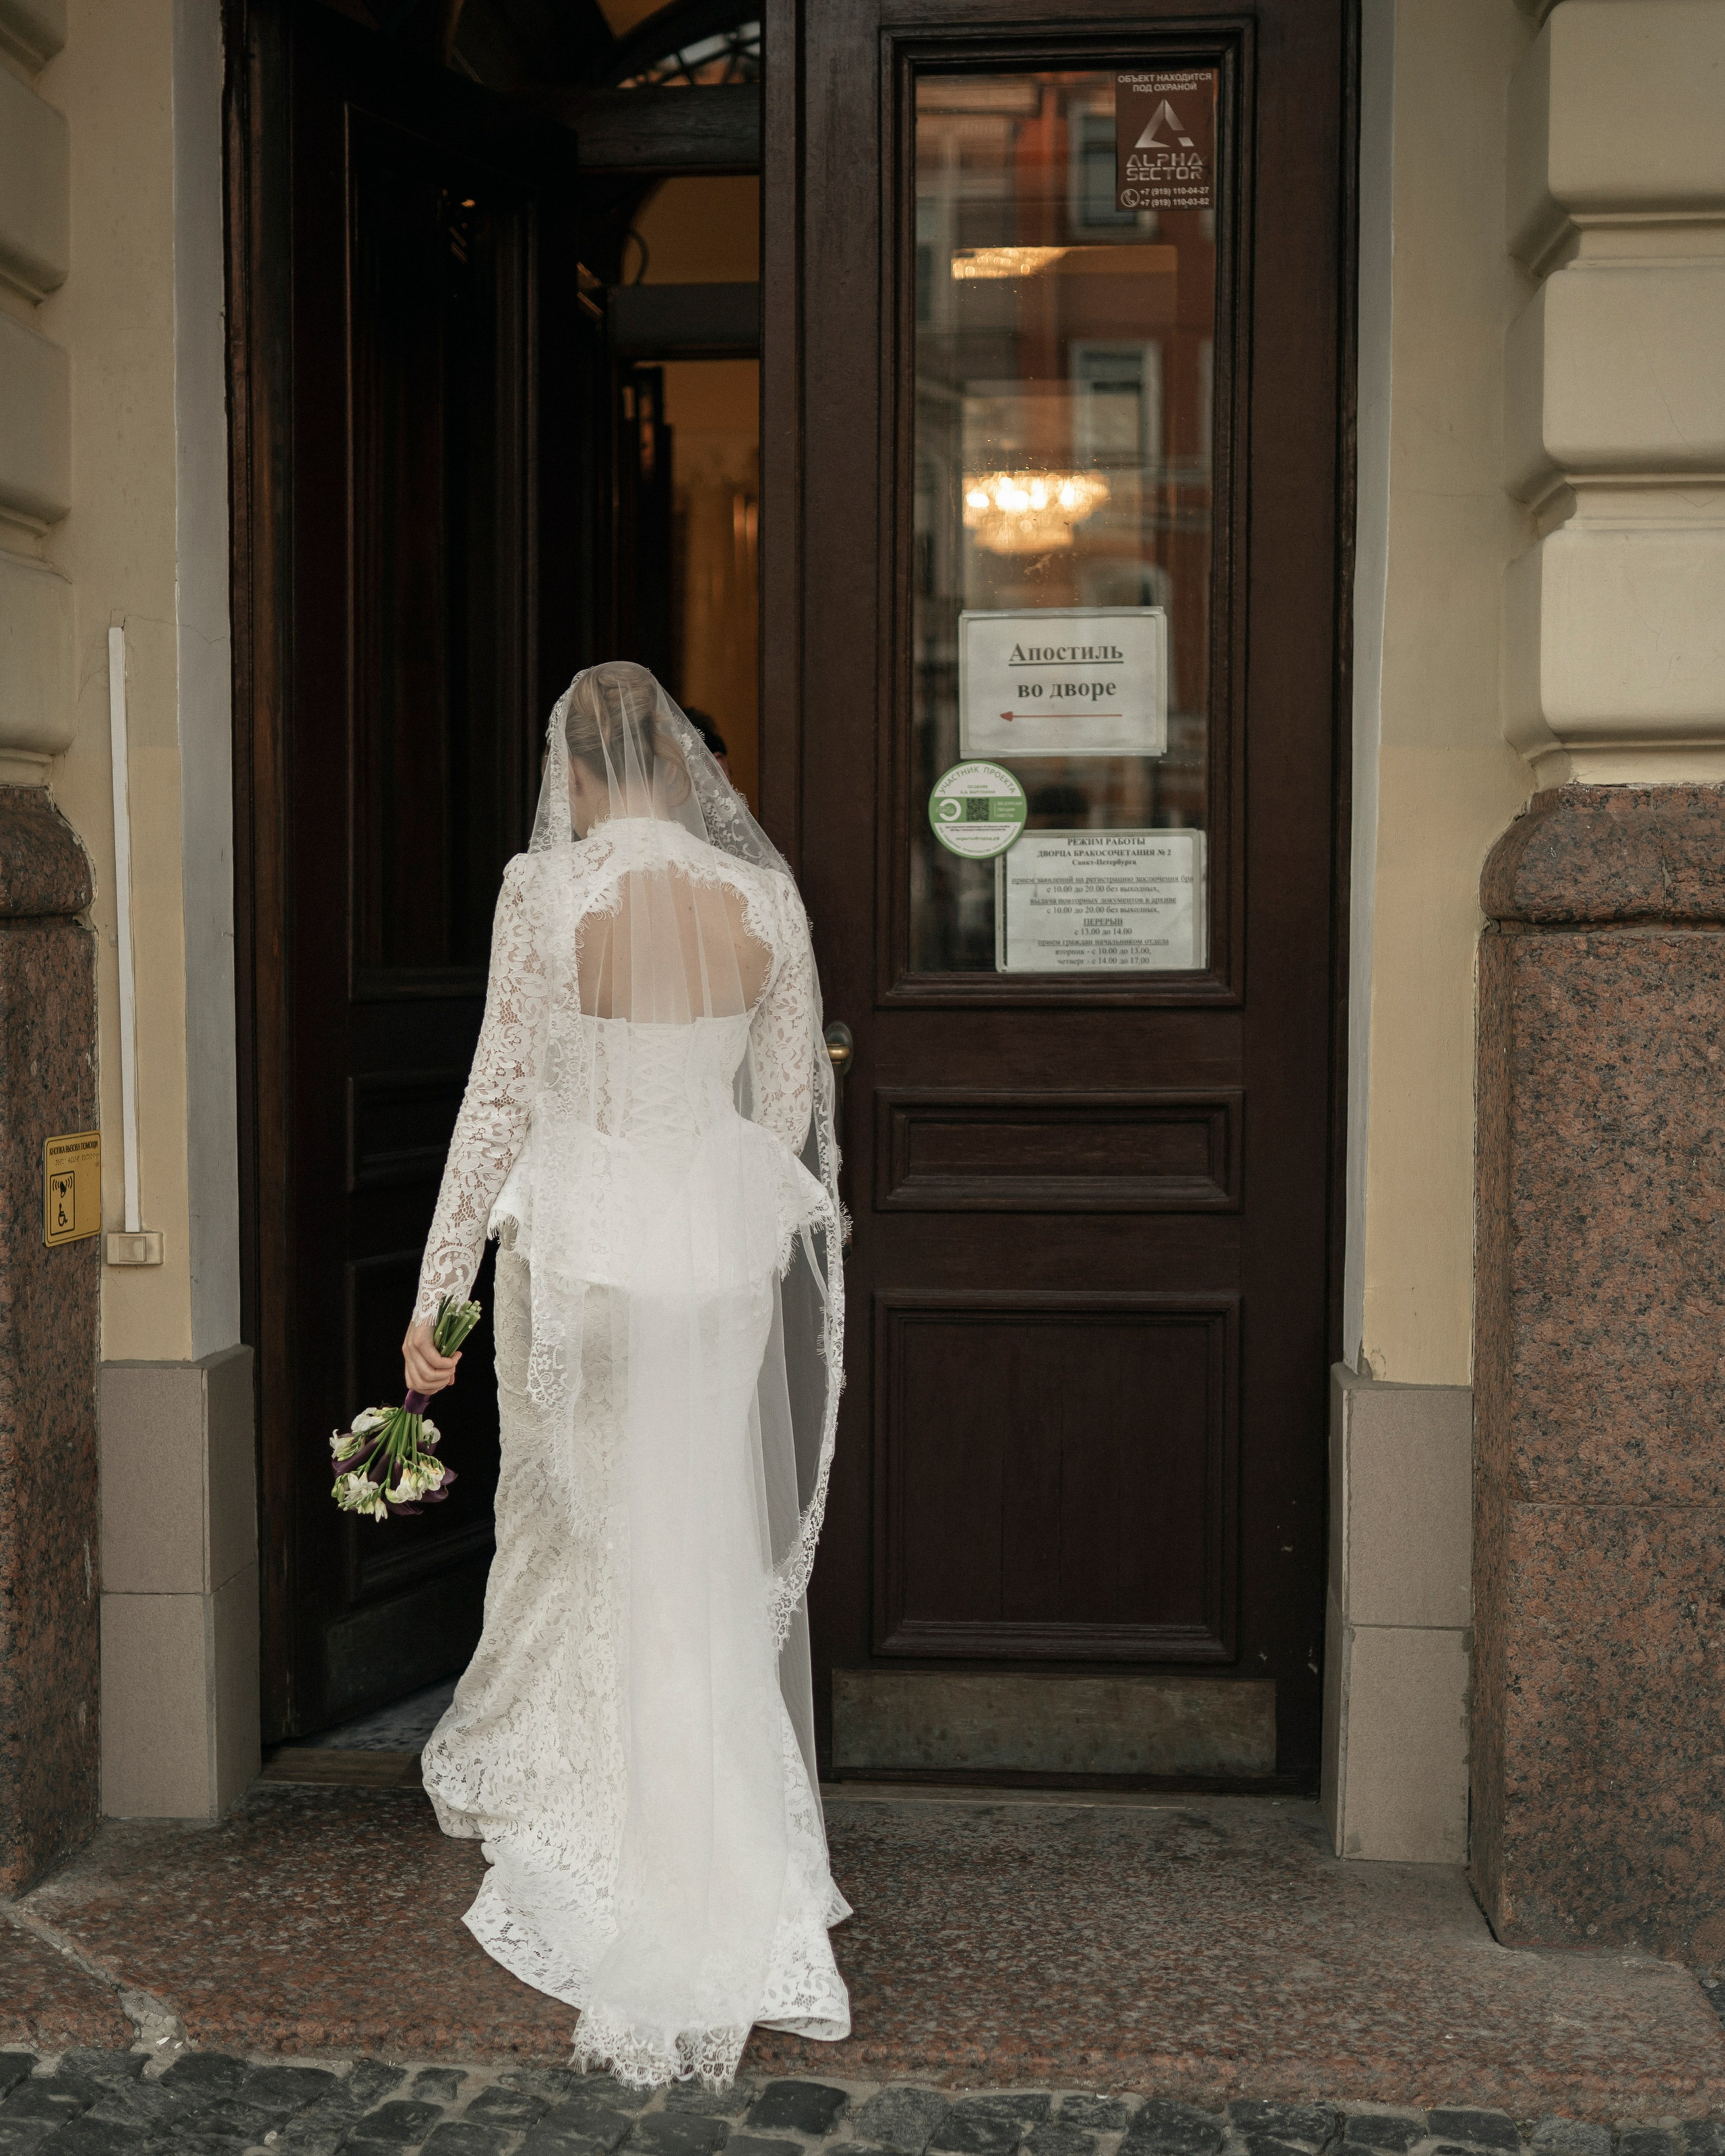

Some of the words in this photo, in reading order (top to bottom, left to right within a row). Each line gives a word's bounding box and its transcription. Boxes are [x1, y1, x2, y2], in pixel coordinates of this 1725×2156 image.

[1118, 75, 1155, 83] ОБЪЕКТ
[1157, 73, 1212, 82] НАХОДИТСЯ
[1133, 84, 1152, 92] ПОД
[1155, 82, 1197, 91] ОХРАНОЙ
[1126, 153, 1203, 167] ALPHA
[1126, 166, 1203, 181] SECTOR
[1009, 643, 1123, 662] Апостиль
[1017, 683, 1043, 698] во
[1049, 682, 1117, 701] дворе
[939, 766, 979, 794] УЧАСТНИК
[983, 766, 1016, 794] ПРОЕКТА
[1106, 837, 1146, 846] РАБОТЫ
[1037, 850, 1071, 858] ДВОРЦА
[1073, 849, 1155, 857] БРАКОСОЧЕТАНИЯ
[1072, 858, 1137, 866] Санкт-Петербурга
[1130, 947, 1151, 955] 13.00,
[49, 1146, 65, 1155] КНОПКА
[65, 1143, 80, 1153] ВЫЗОВА
[81, 1140, 98, 1150] ПОМОЩИ
